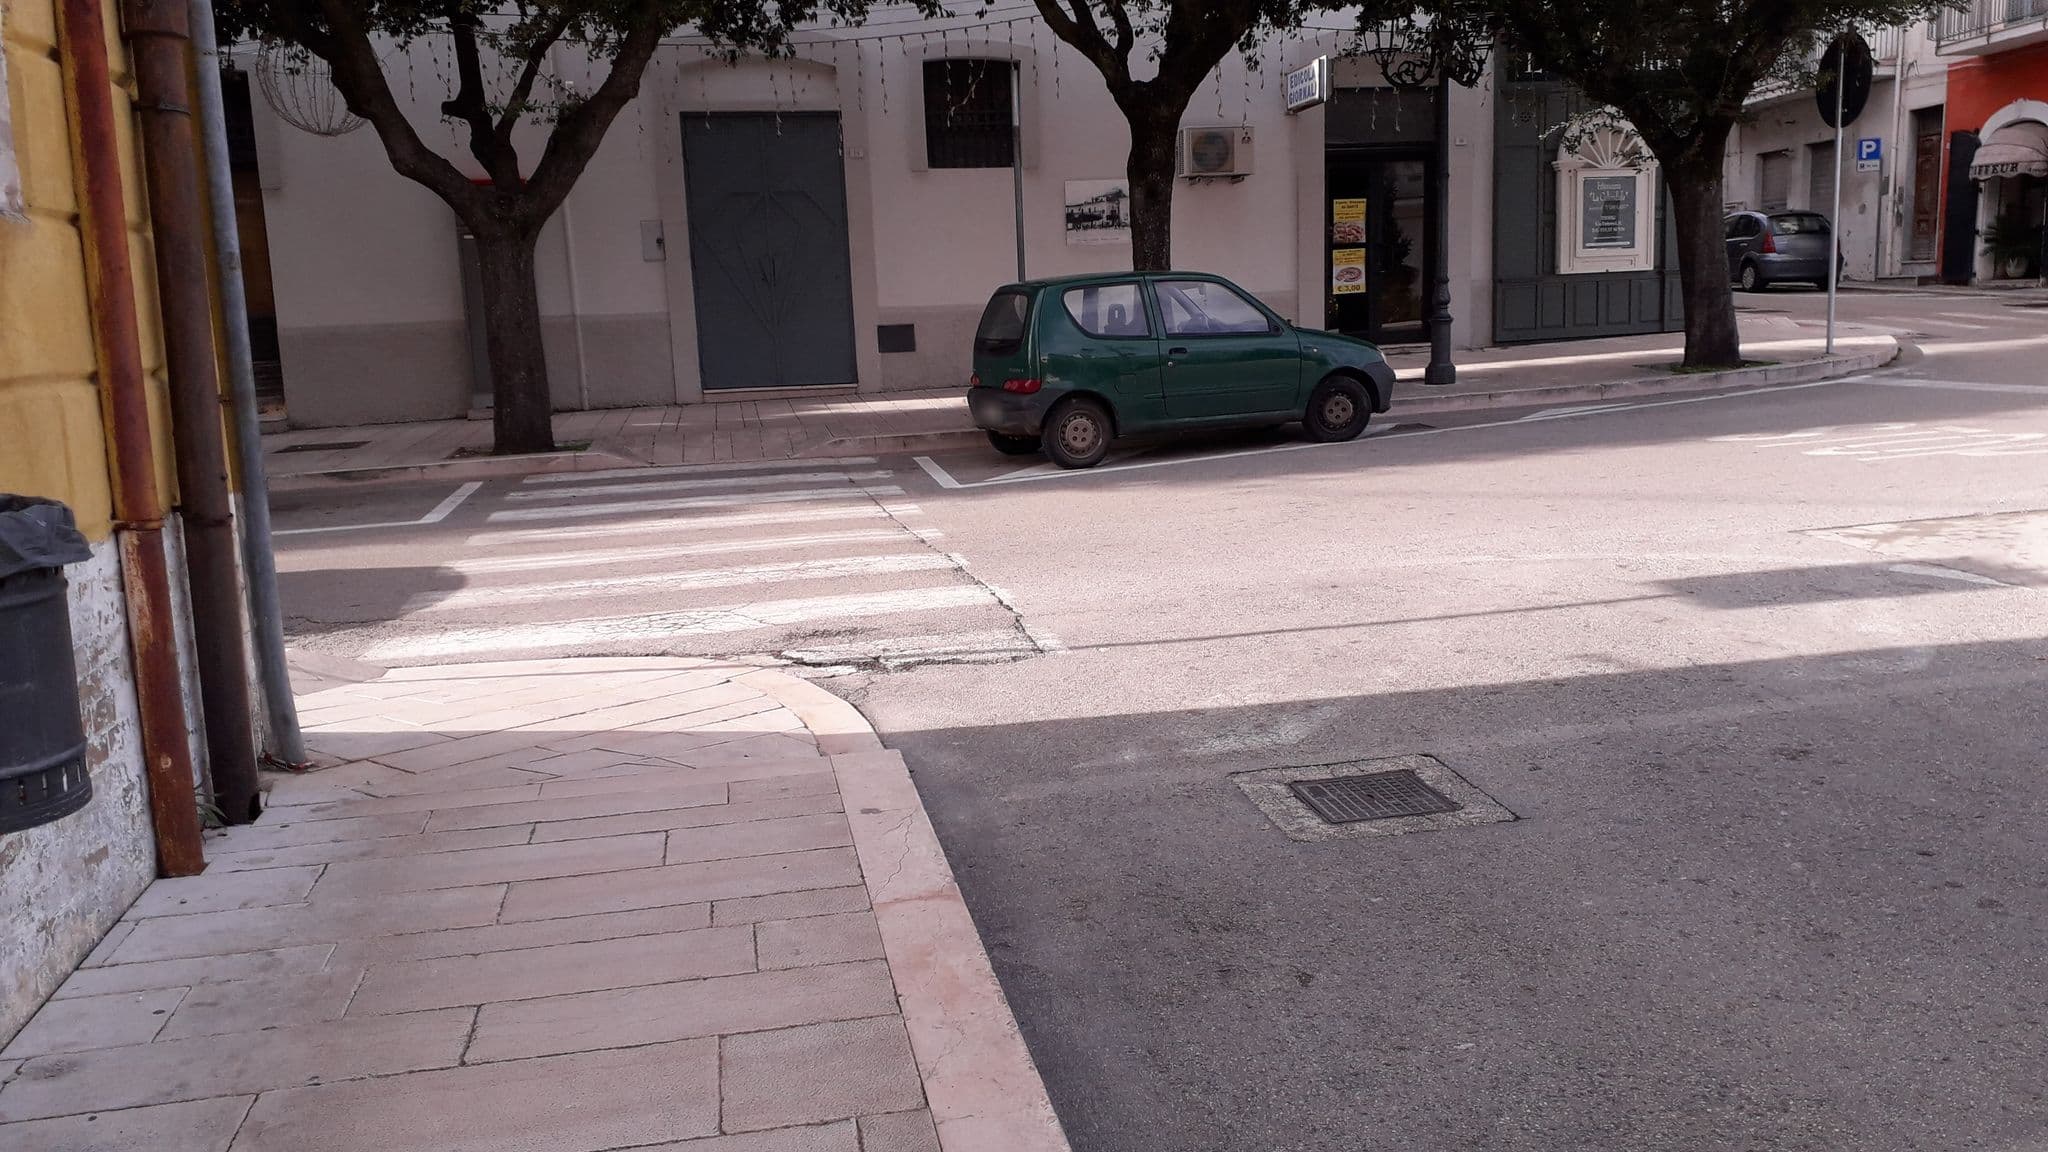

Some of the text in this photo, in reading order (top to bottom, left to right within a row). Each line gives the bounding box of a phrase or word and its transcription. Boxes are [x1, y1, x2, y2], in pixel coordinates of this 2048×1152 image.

[1290, 65, 1315, 89] EDICOLA
[1289, 82, 1316, 104] GIORNALI
[1862, 141, 1877, 159] P
[1969, 162, 2018, 176] IFFEUR
